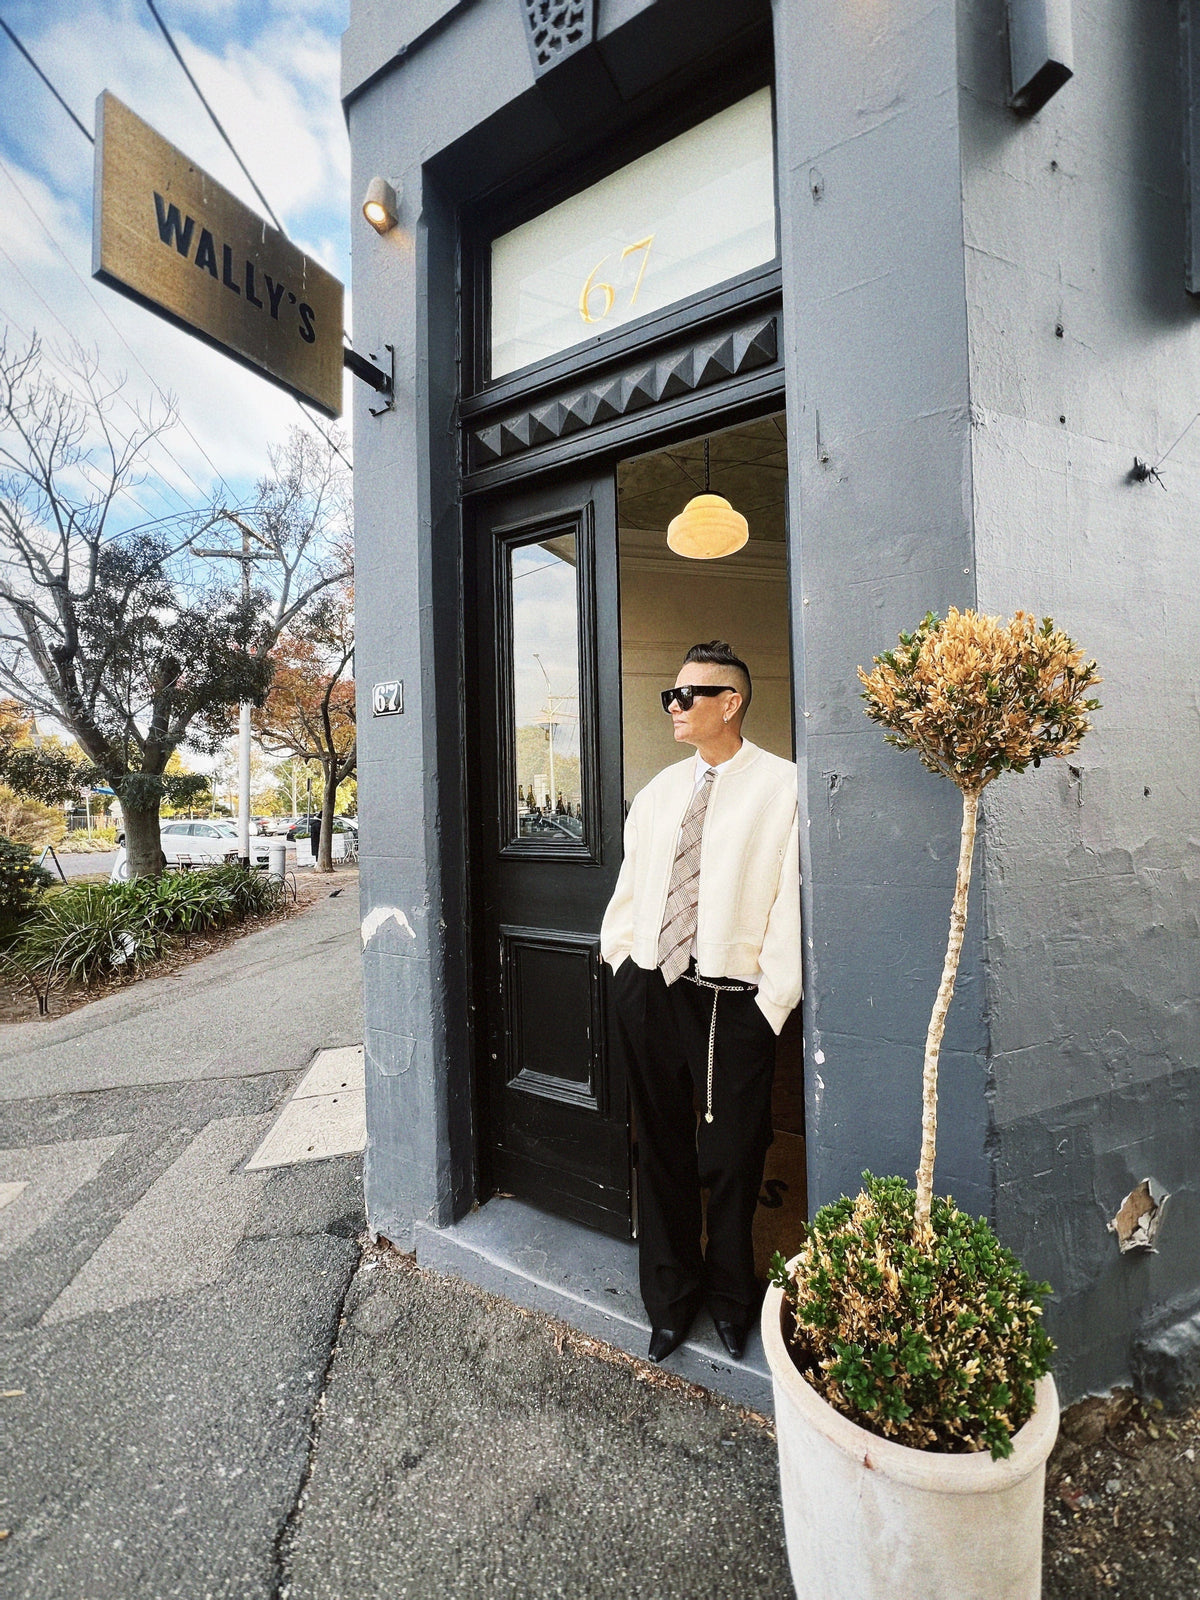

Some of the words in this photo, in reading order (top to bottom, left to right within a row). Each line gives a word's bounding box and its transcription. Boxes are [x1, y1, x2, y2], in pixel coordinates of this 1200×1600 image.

[153, 191, 316, 344] WALLY'S
[579, 234, 655, 323] 67
[375, 684, 397, 712] 67
